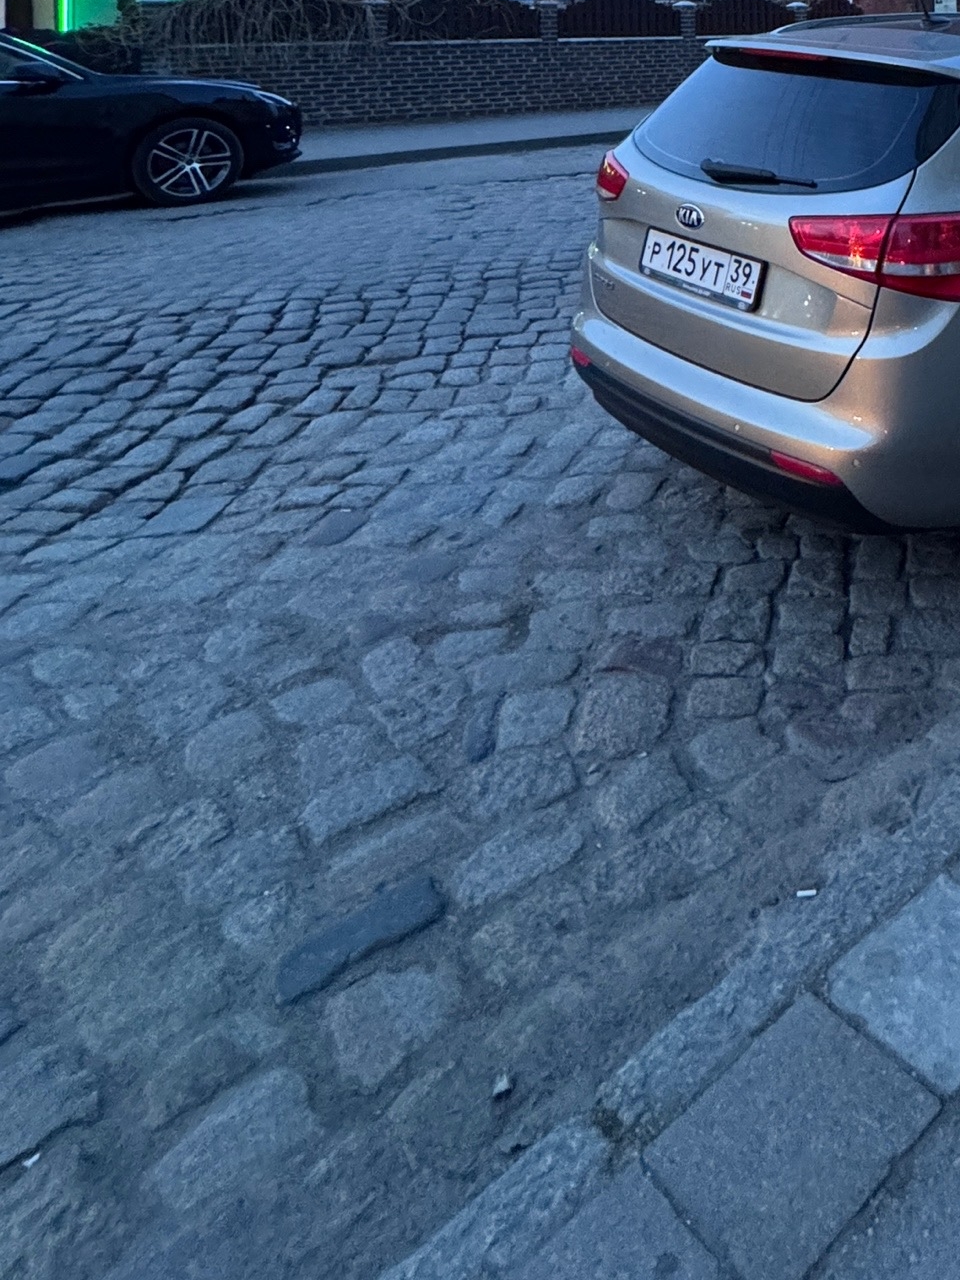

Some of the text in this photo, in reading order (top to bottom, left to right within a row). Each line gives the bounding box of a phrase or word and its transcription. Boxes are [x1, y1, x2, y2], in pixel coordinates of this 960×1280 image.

[678, 207, 698, 226] KIA
[729, 258, 753, 287] 39
[725, 282, 741, 296] RUS
